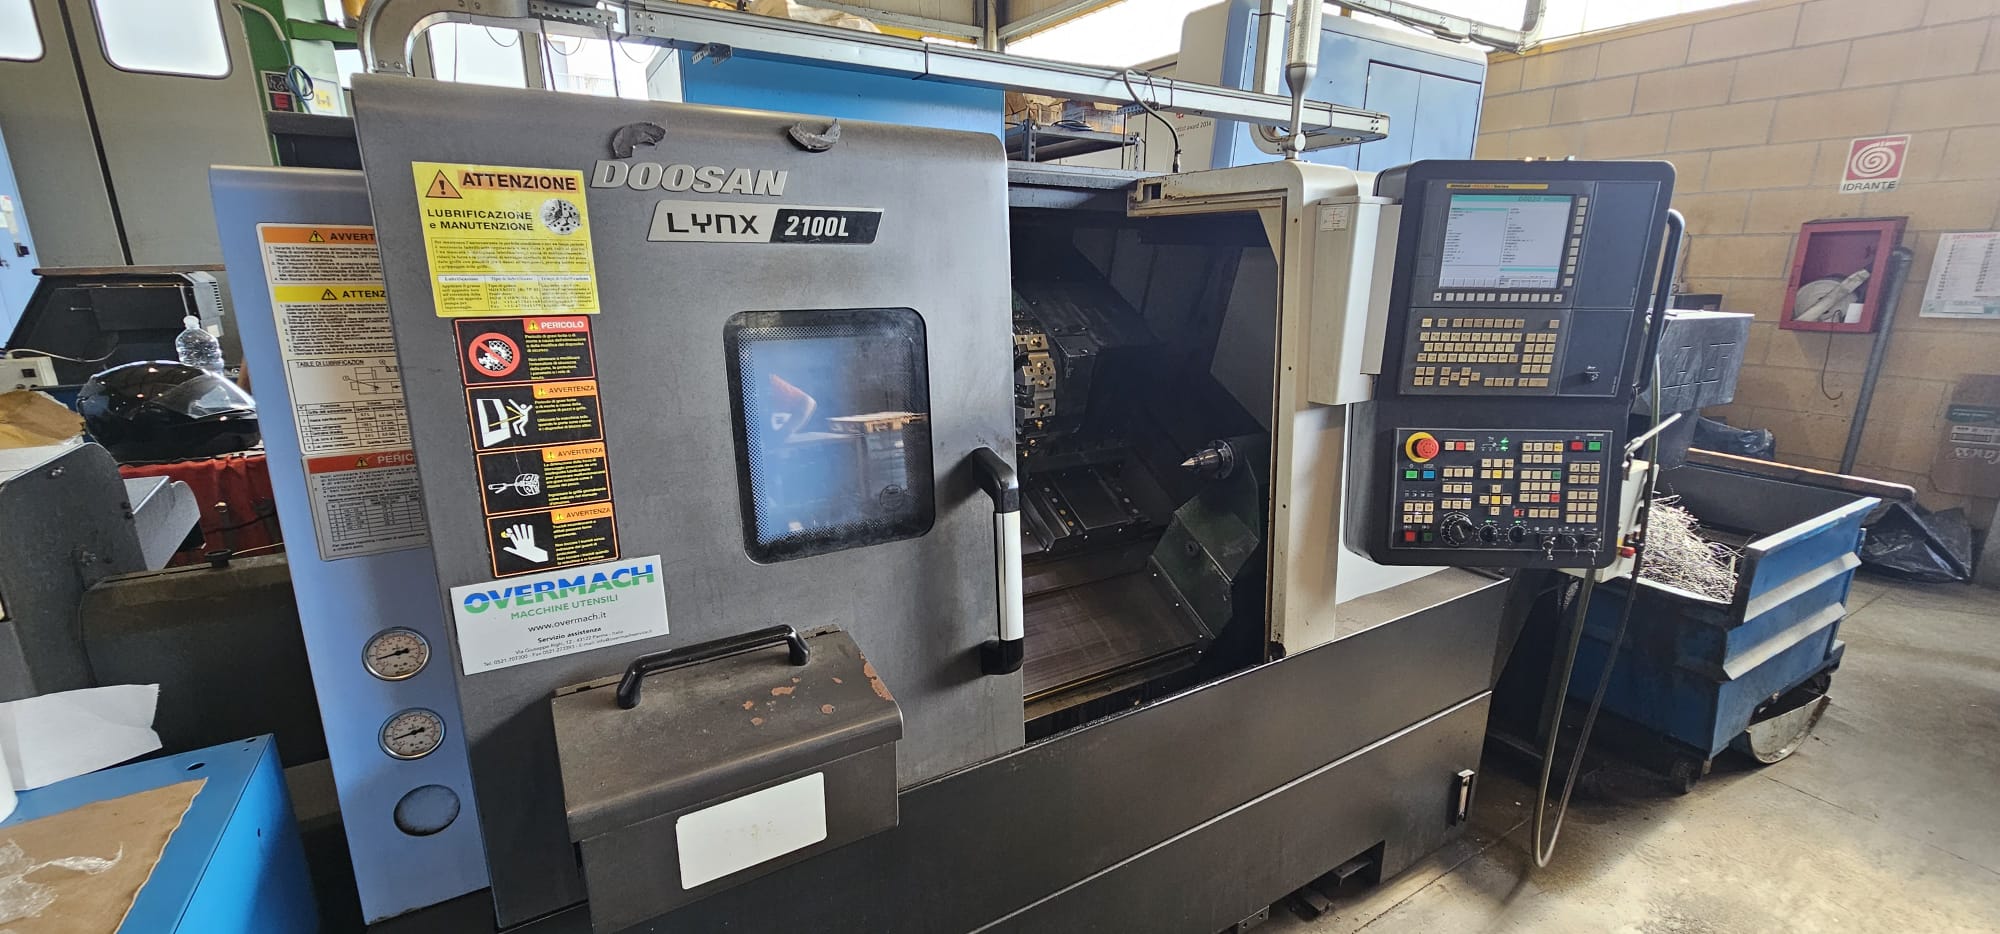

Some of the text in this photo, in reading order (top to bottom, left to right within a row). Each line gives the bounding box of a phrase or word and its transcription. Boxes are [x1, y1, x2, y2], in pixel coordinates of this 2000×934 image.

[462, 172, 577, 191] ATTENZIONE
[590, 160, 788, 196] DOOSAN
[1843, 180, 1896, 192] IDRANTE
[427, 209, 532, 220] LUBRIFICAZIONE
[440, 221, 533, 231] MANUTENZIONE
[784, 215, 849, 237] 2100L
[330, 232, 375, 241] AVVERT
[342, 290, 386, 298] ATTENZ
[541, 321, 584, 329] PERICOLO
[549, 386, 595, 394] AVVERTENZA
[558, 447, 602, 457] AVVERTENZA
[377, 453, 414, 464] PERIC
[566, 508, 611, 518] AVVERTENZA
[464, 564, 655, 614] OVERMACH
[511, 594, 618, 620] MACCHINE UTENSILI
[528, 612, 607, 633] www.overmach.it
[537, 627, 602, 643] Servizio assistenza
